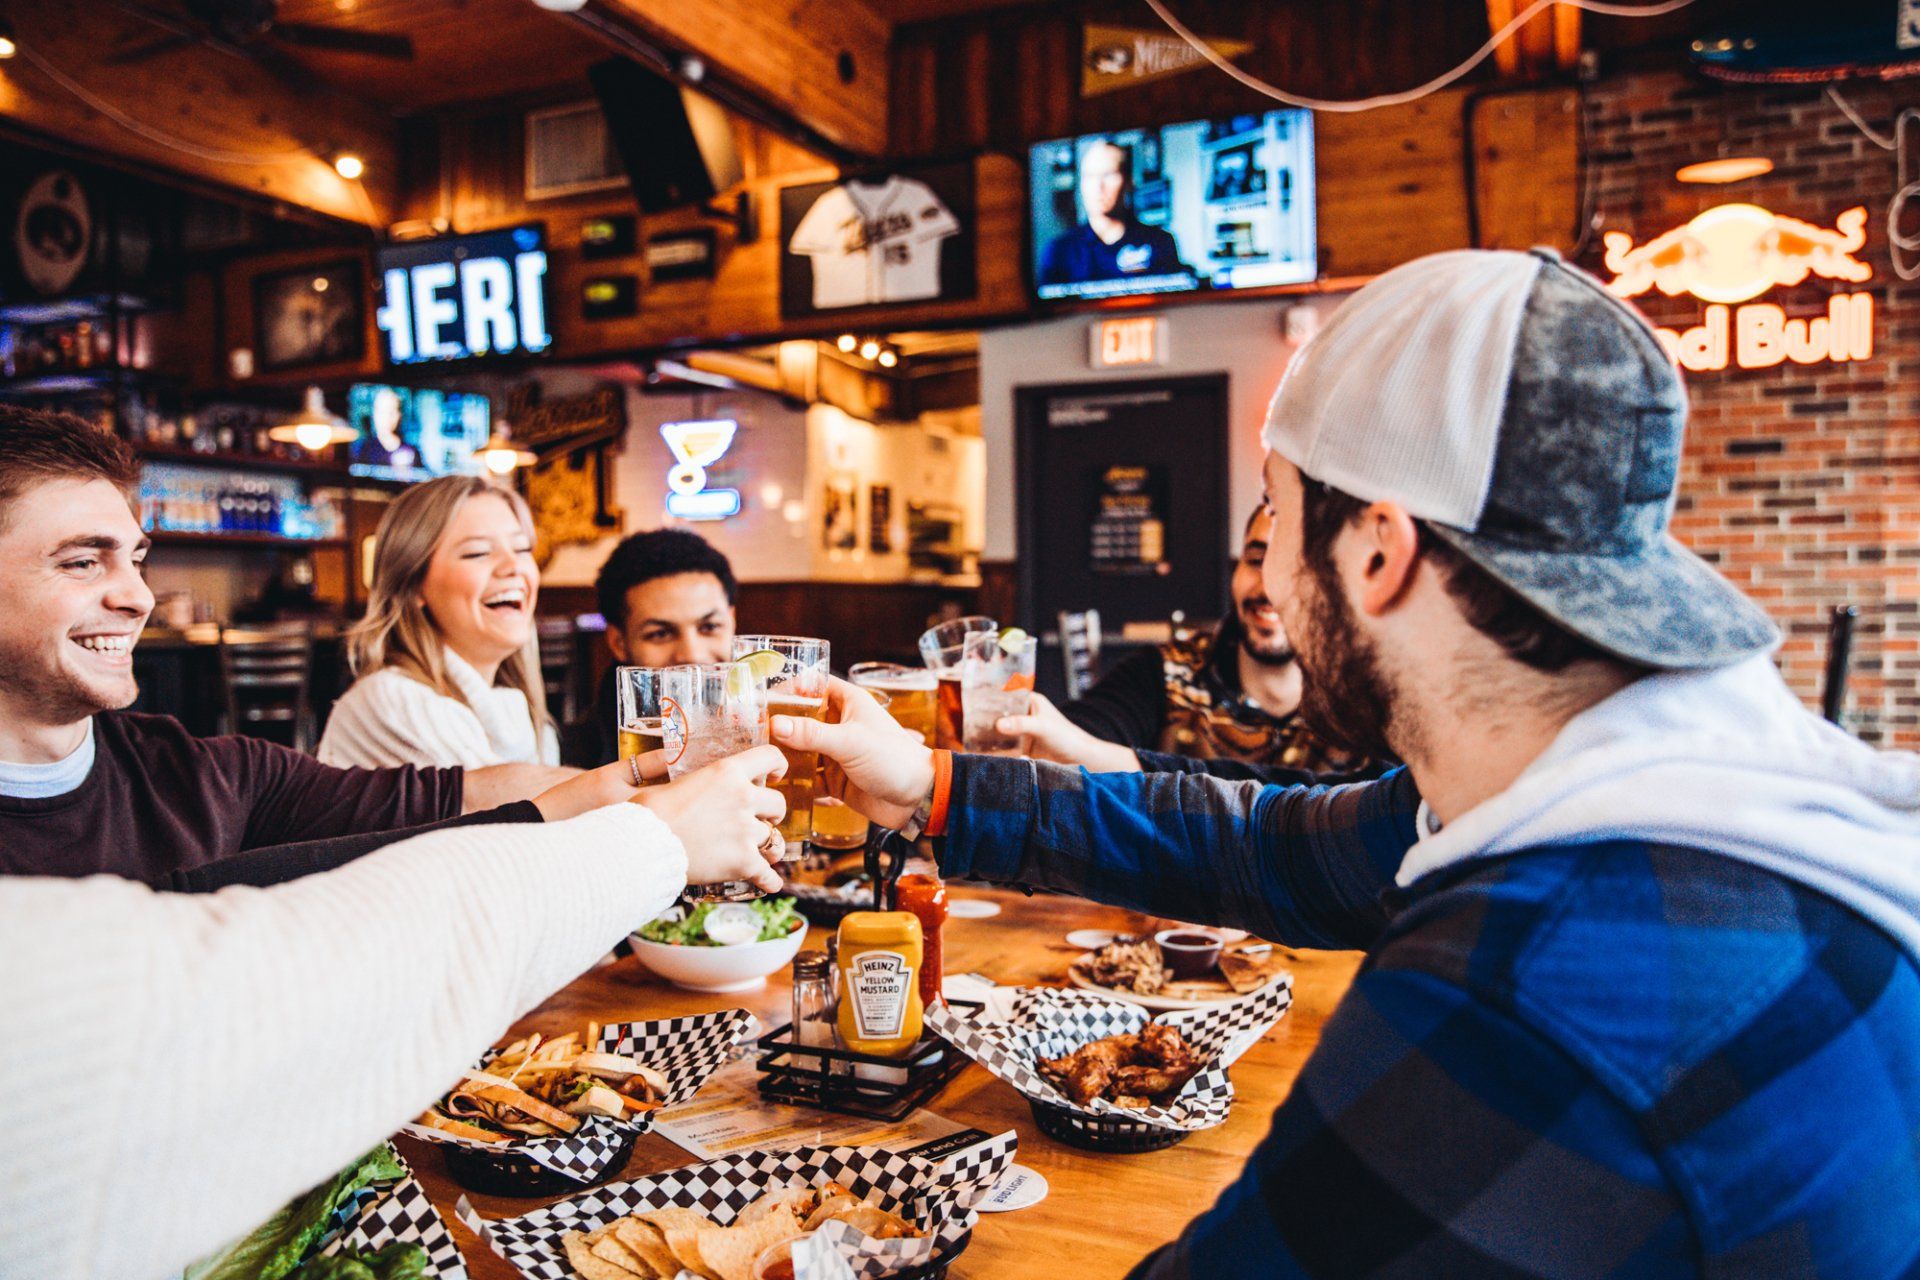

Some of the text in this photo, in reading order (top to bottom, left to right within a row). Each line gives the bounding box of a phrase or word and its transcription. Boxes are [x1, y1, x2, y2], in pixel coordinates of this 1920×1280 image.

[1736, 291, 1874, 369] Bull
[864, 961, 894, 972] HEINZ
[865, 977, 894, 985] YELLOW
[861, 985, 899, 994] MUSTARD
[931, 1141, 955, 1152] and
[953, 1133, 980, 1147] Grill
[993, 1189, 1010, 1204] BUD
[1007, 1174, 1028, 1196] LIGHT
